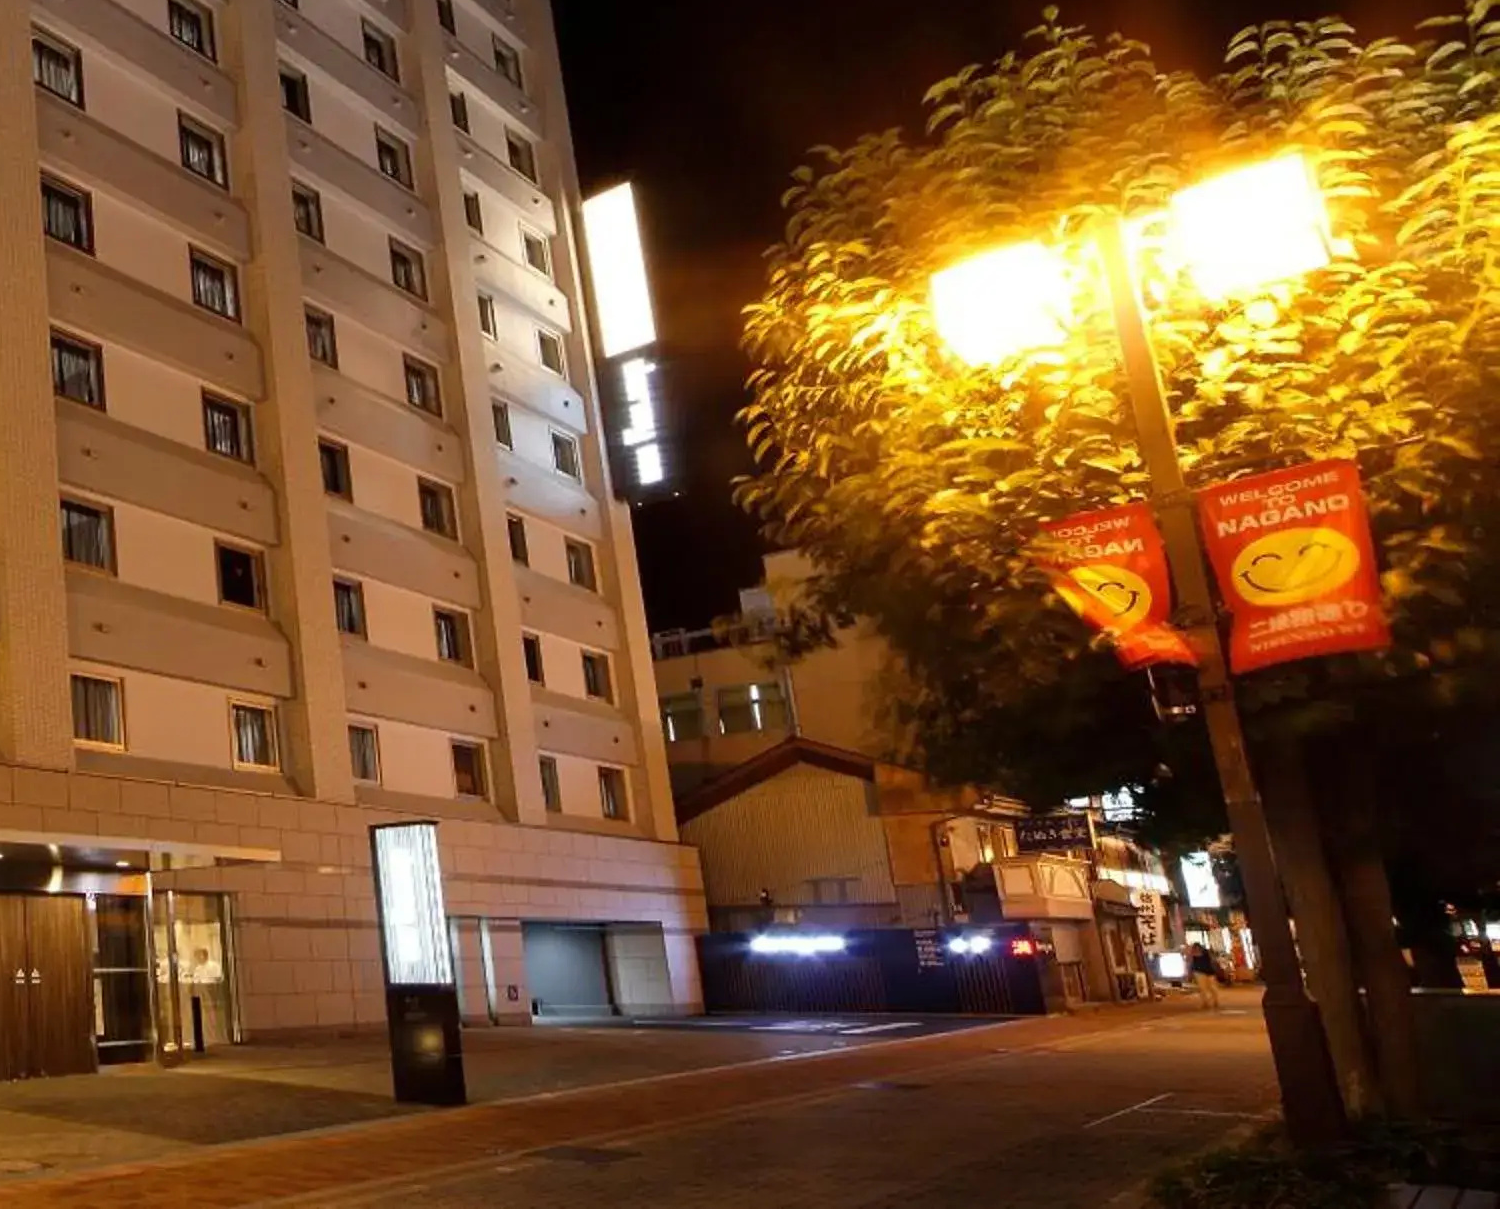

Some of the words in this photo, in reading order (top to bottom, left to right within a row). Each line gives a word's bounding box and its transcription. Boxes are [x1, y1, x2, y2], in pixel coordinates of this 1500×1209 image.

[1219, 471, 1340, 507] WELCOME
[1266, 493, 1296, 508] TO
[1217, 494, 1350, 539] NAGANO
